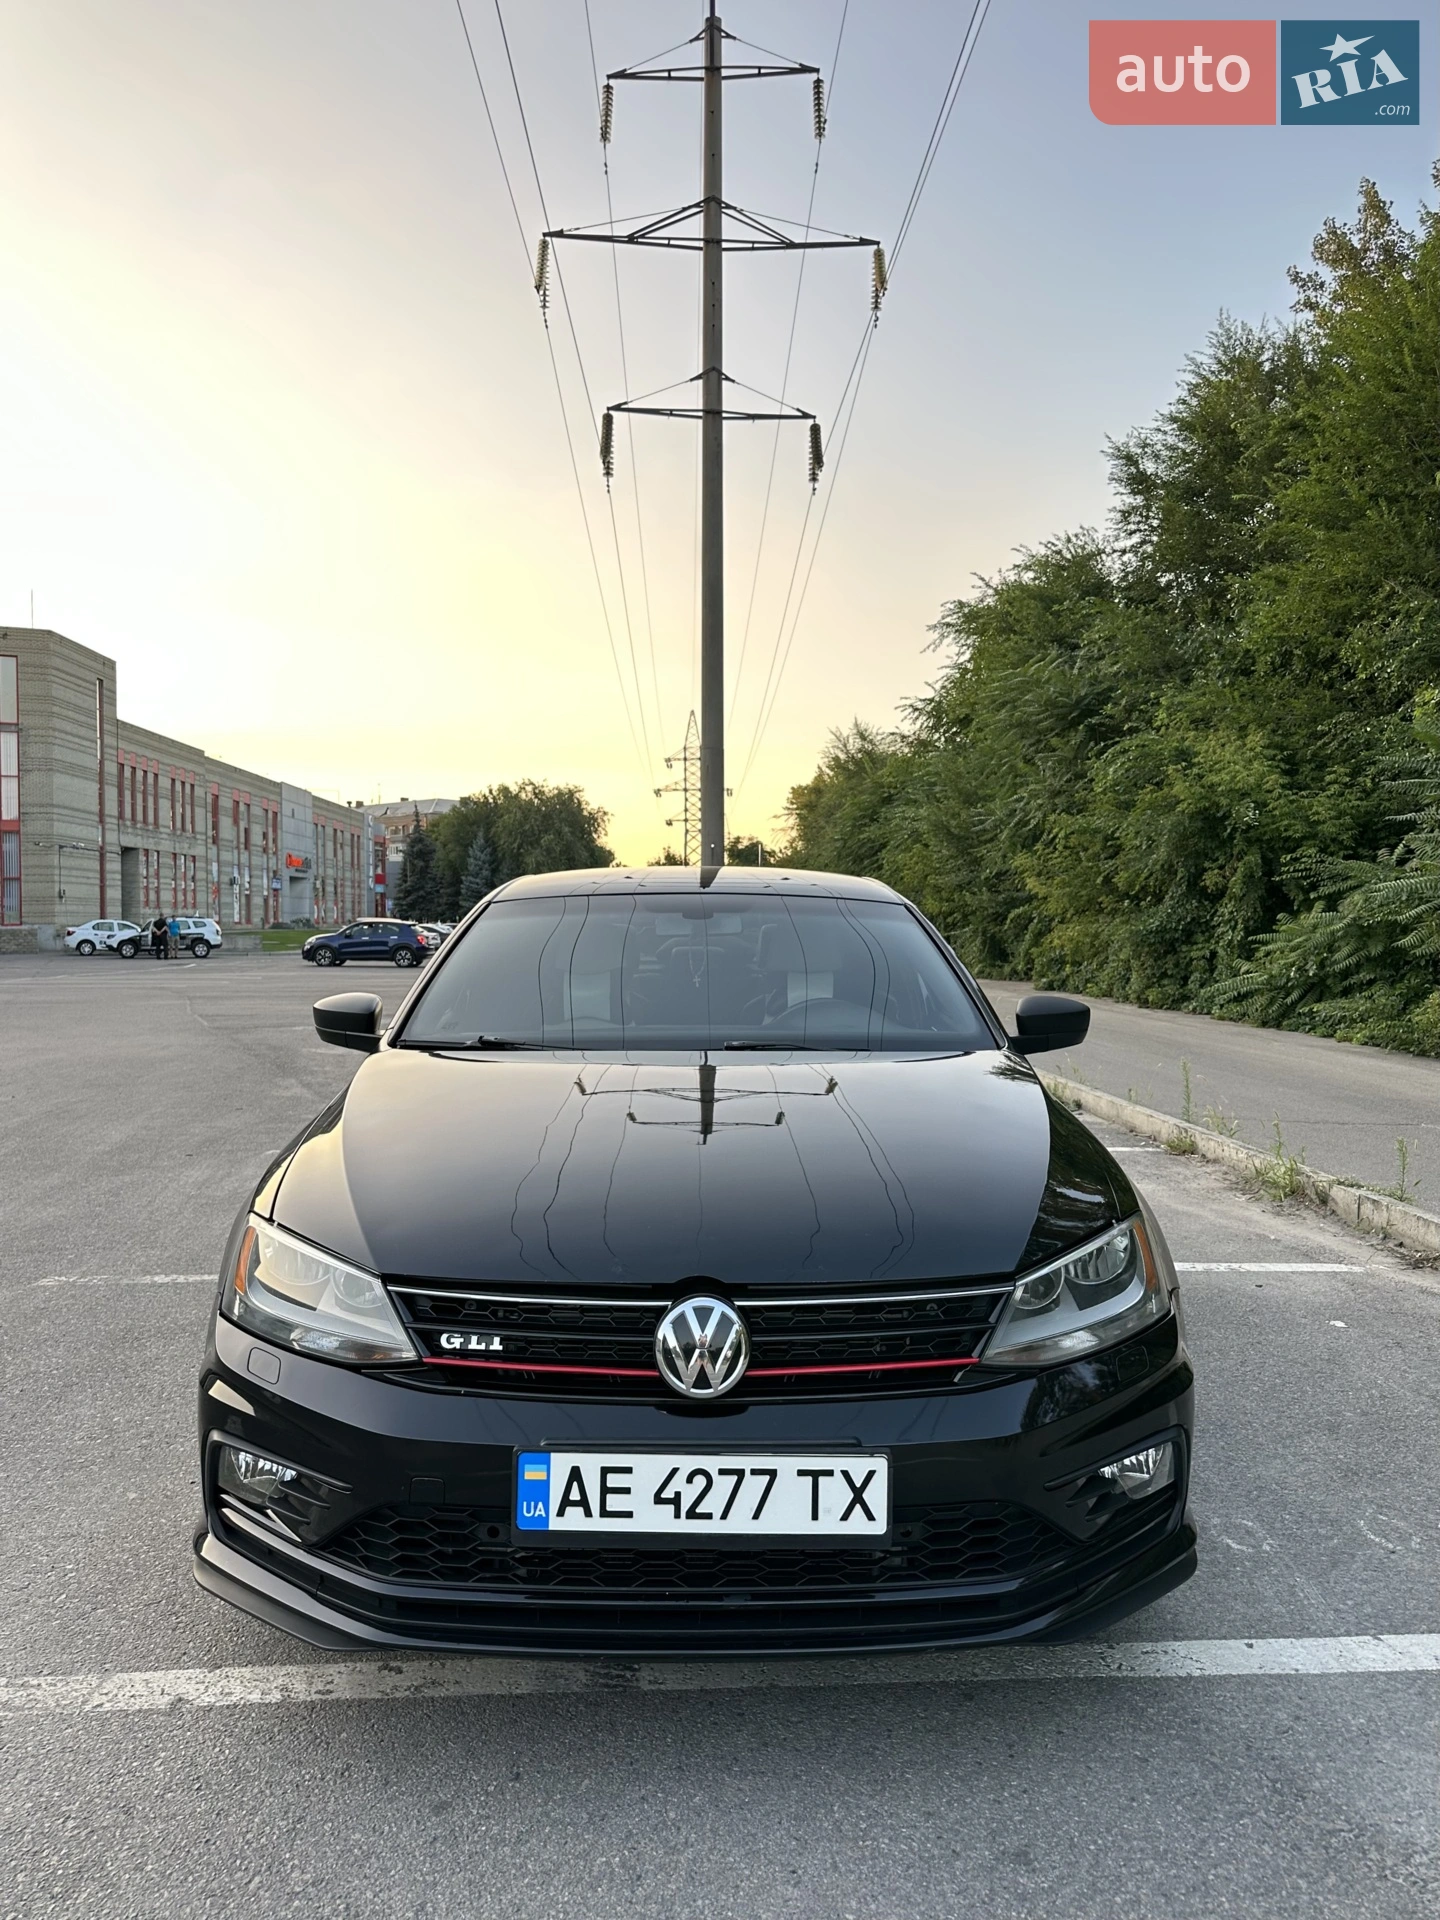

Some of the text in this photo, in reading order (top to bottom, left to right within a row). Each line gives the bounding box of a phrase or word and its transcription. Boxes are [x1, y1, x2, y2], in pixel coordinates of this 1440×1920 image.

[440, 1333, 503, 1351] GLI
[656, 1296, 747, 1397] VW
[522, 1501, 546, 1518] UA
[556, 1465, 877, 1522] AE 4277 TX
